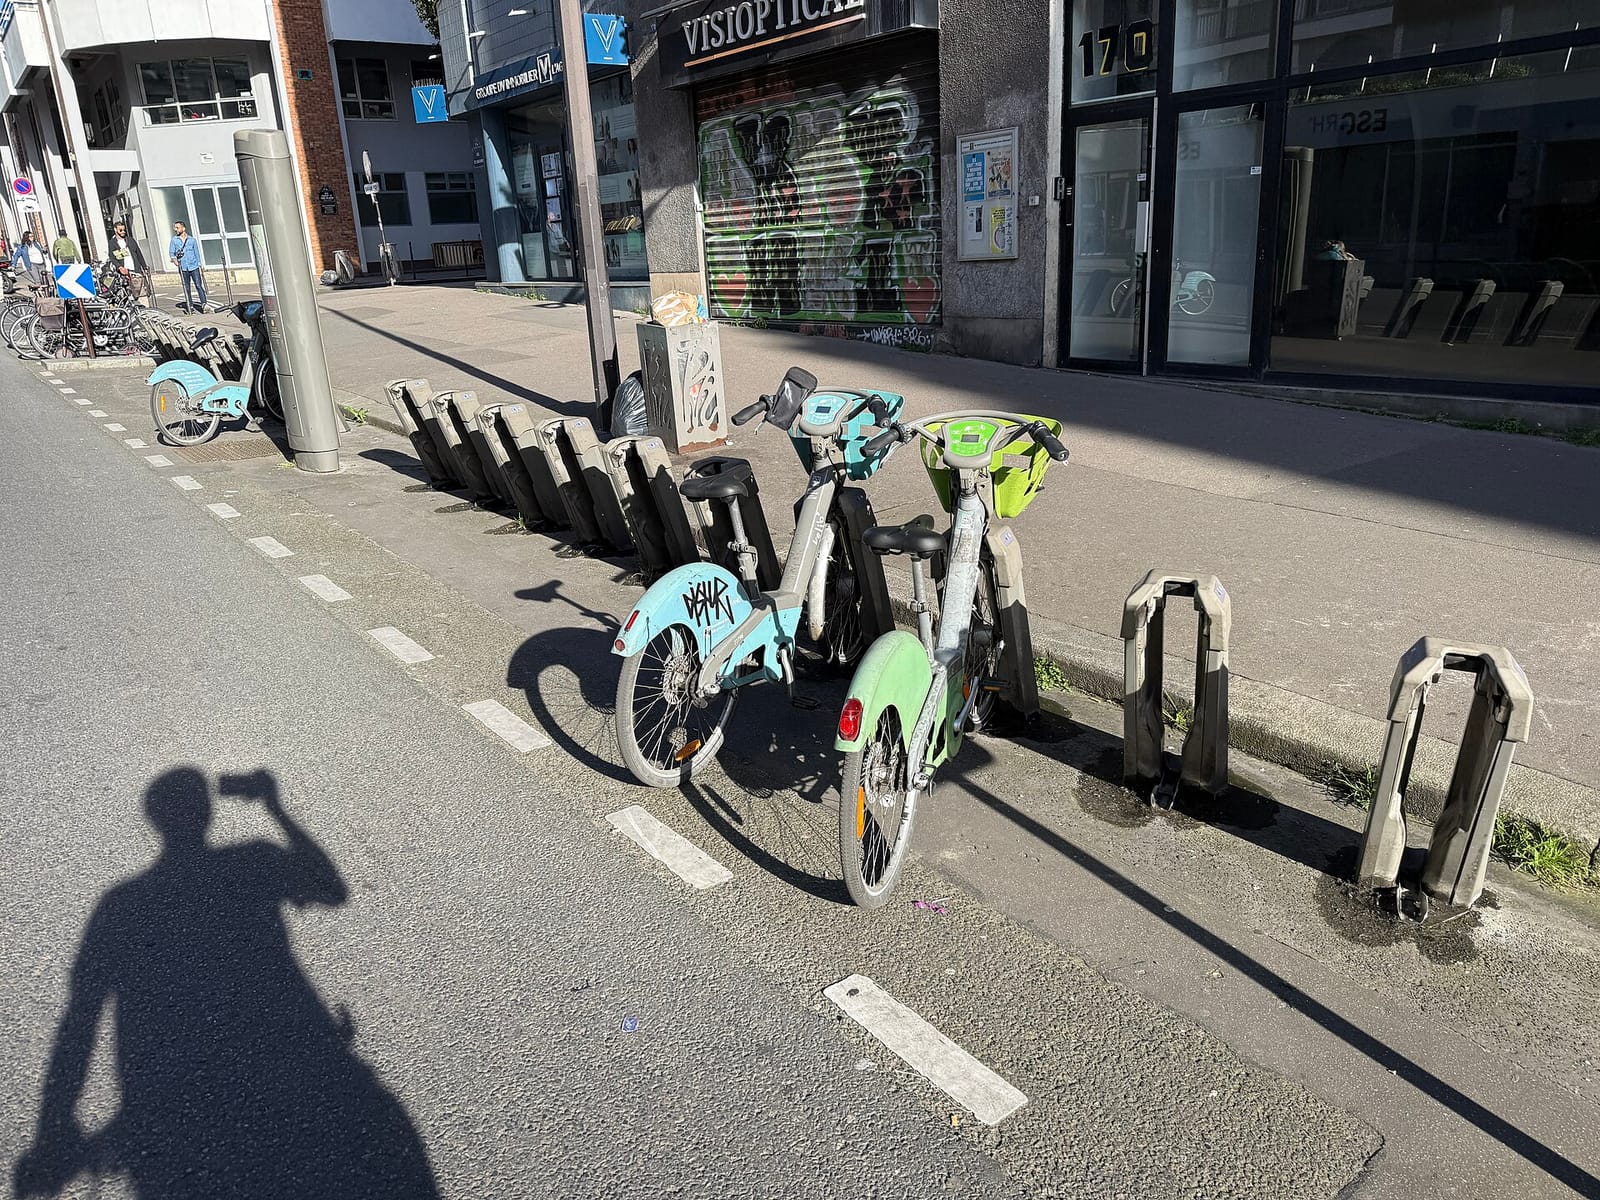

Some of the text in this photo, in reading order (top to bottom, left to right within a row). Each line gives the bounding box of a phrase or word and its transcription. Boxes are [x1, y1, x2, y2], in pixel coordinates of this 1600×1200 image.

[592, 18, 617, 53] V
[1078, 18, 1153, 79] 170
[417, 89, 437, 114] V
